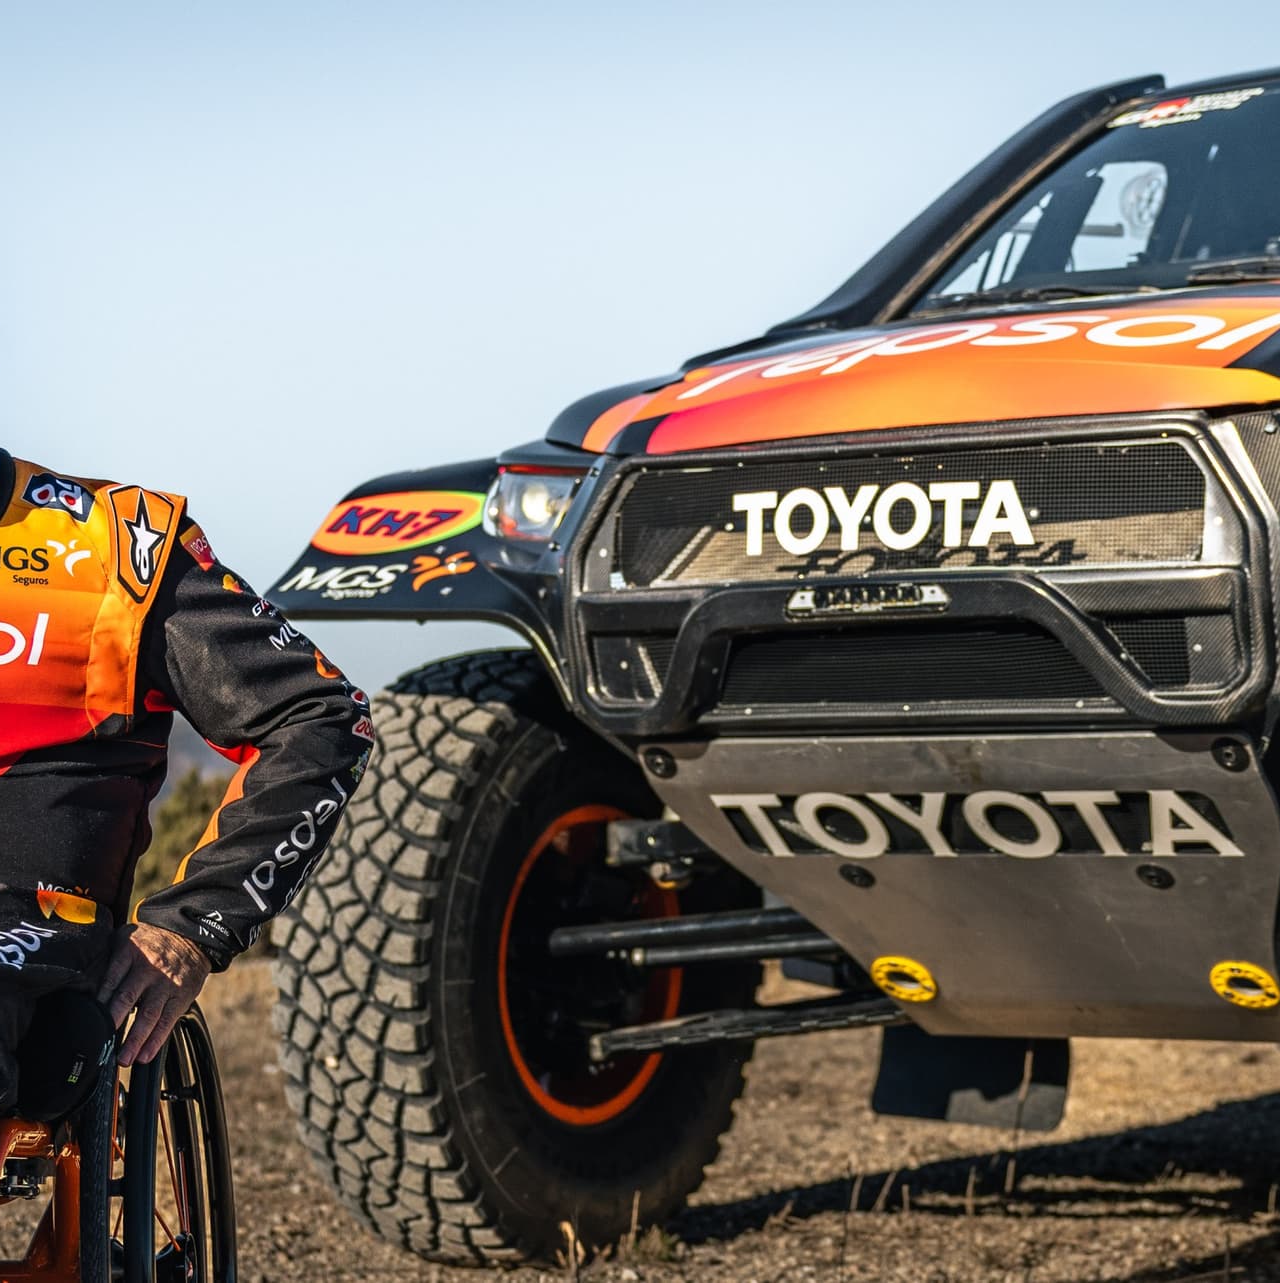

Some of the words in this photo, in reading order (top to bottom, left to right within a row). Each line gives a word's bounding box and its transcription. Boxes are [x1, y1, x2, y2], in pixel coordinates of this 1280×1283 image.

[731, 479, 1037, 557] TOYOTA
[12, 574, 49, 586] Seguros
[278, 564, 408, 592] MGS
[242, 777, 348, 913] repsol
[709, 790, 1245, 858] TOYOTA
